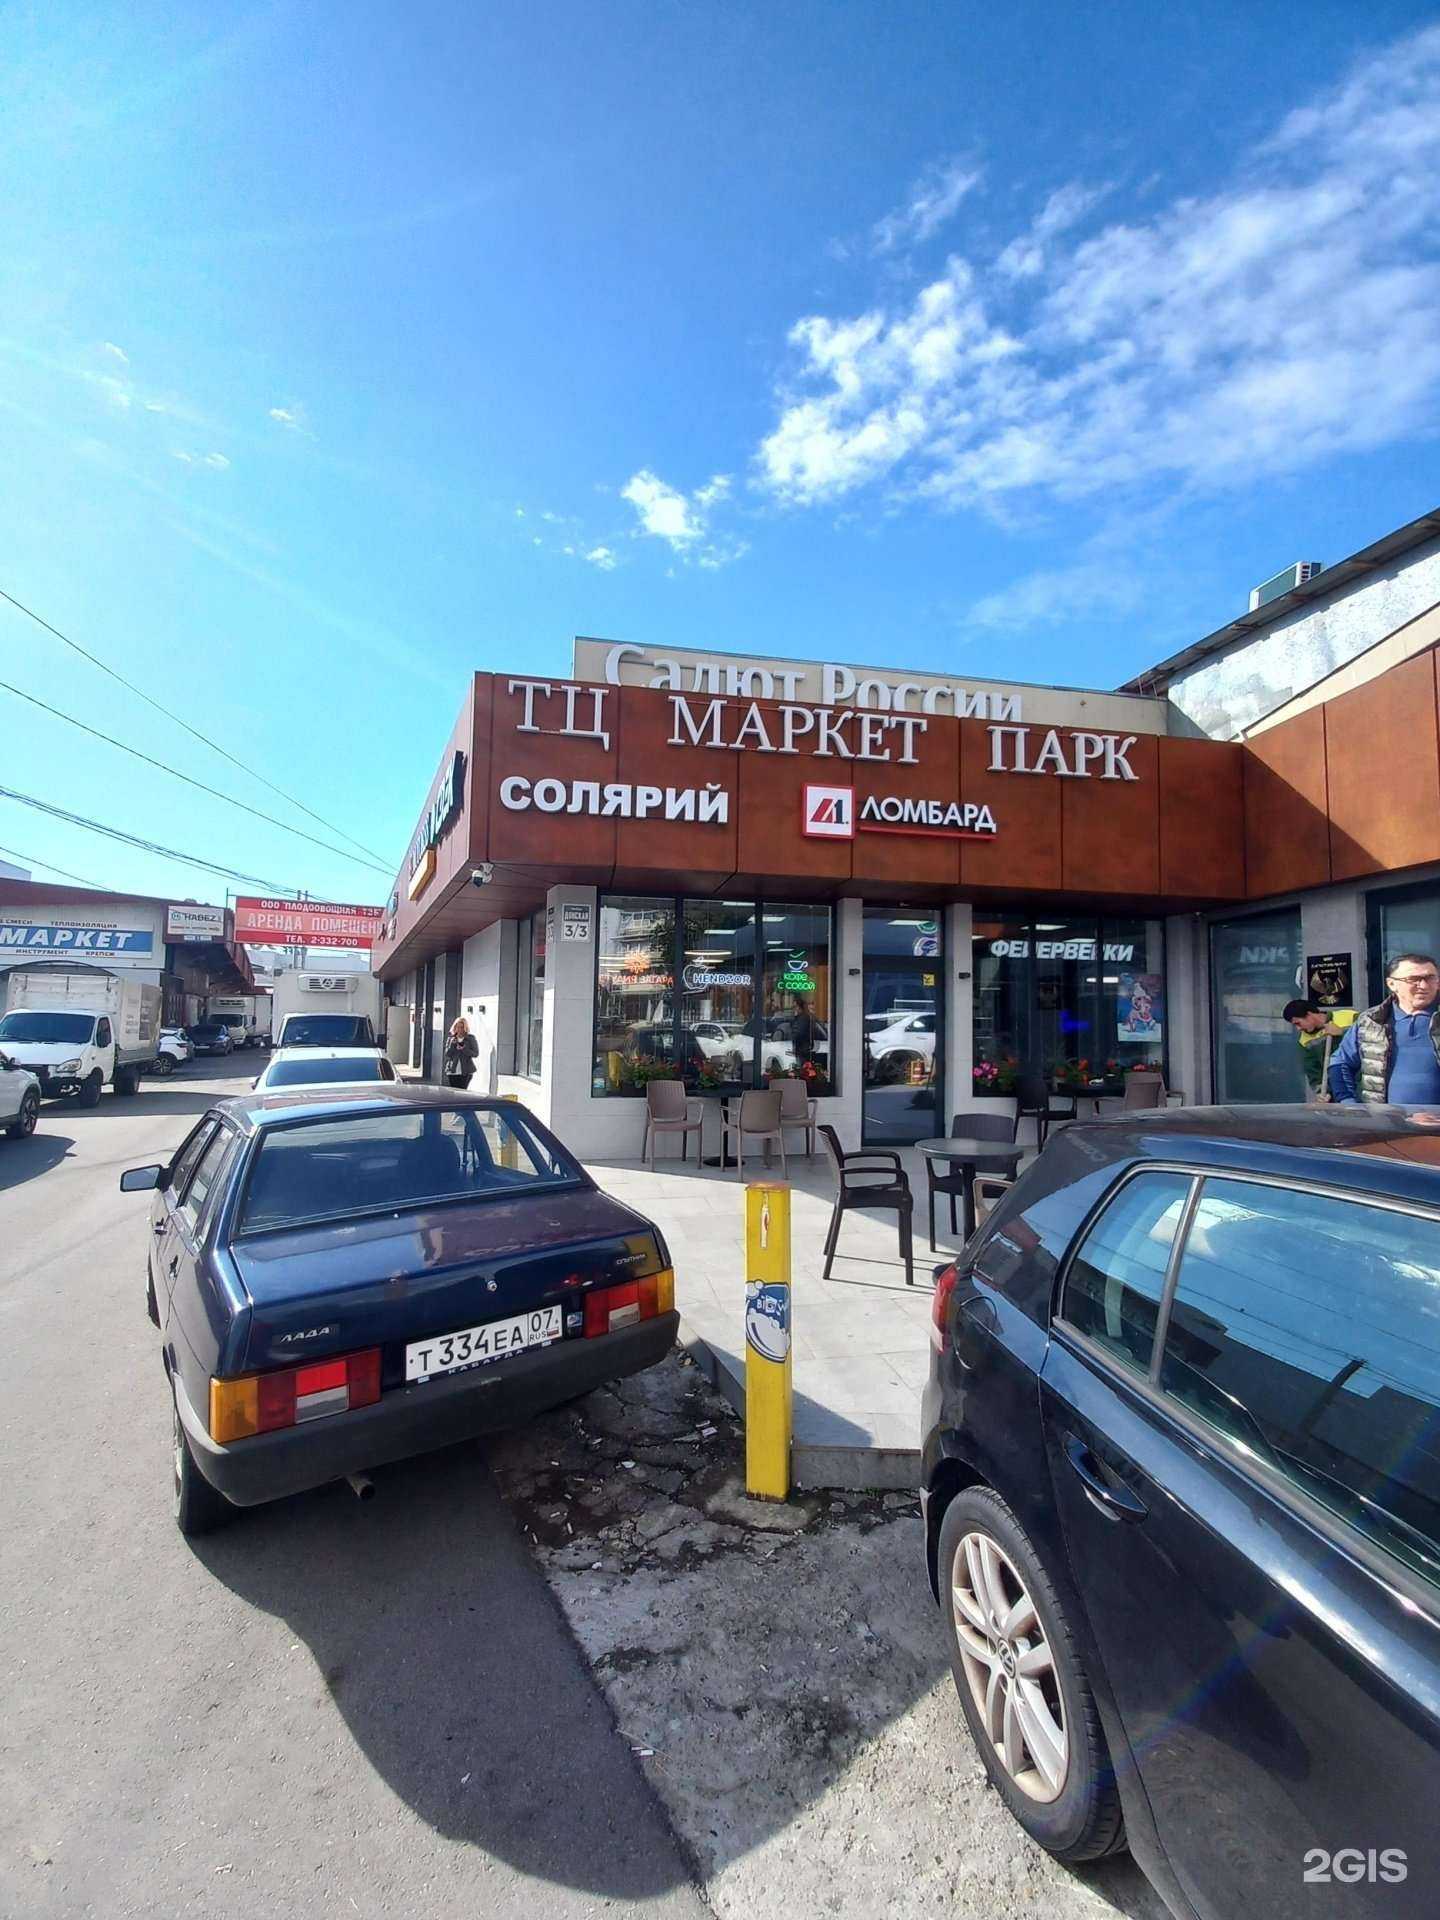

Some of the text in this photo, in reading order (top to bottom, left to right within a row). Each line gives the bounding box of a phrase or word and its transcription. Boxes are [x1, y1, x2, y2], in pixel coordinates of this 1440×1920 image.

[508, 680, 1140, 781] ТЦ МАРКЕТ ПАРК
[500, 776, 729, 824] СОЛЯРИЙ
[860, 796, 997, 834] ЛОМБАРД
[261, 900, 280, 909] ООО
[51, 920, 118, 929] ТЕПЛОИЗОЛЯЦИЯ
[247, 912, 302, 931] АРЕНДА
[0, 926, 133, 949] МАРКЕТ
[564, 923, 588, 938] 3/3
[310, 936, 358, 946] 2-332-700
[16, 948, 69, 956] ИНСТРУМЕНТ
[531, 1310, 553, 1332] 07
[280, 1326, 330, 1343] ЛАДА
[529, 1332, 547, 1342] RUS
